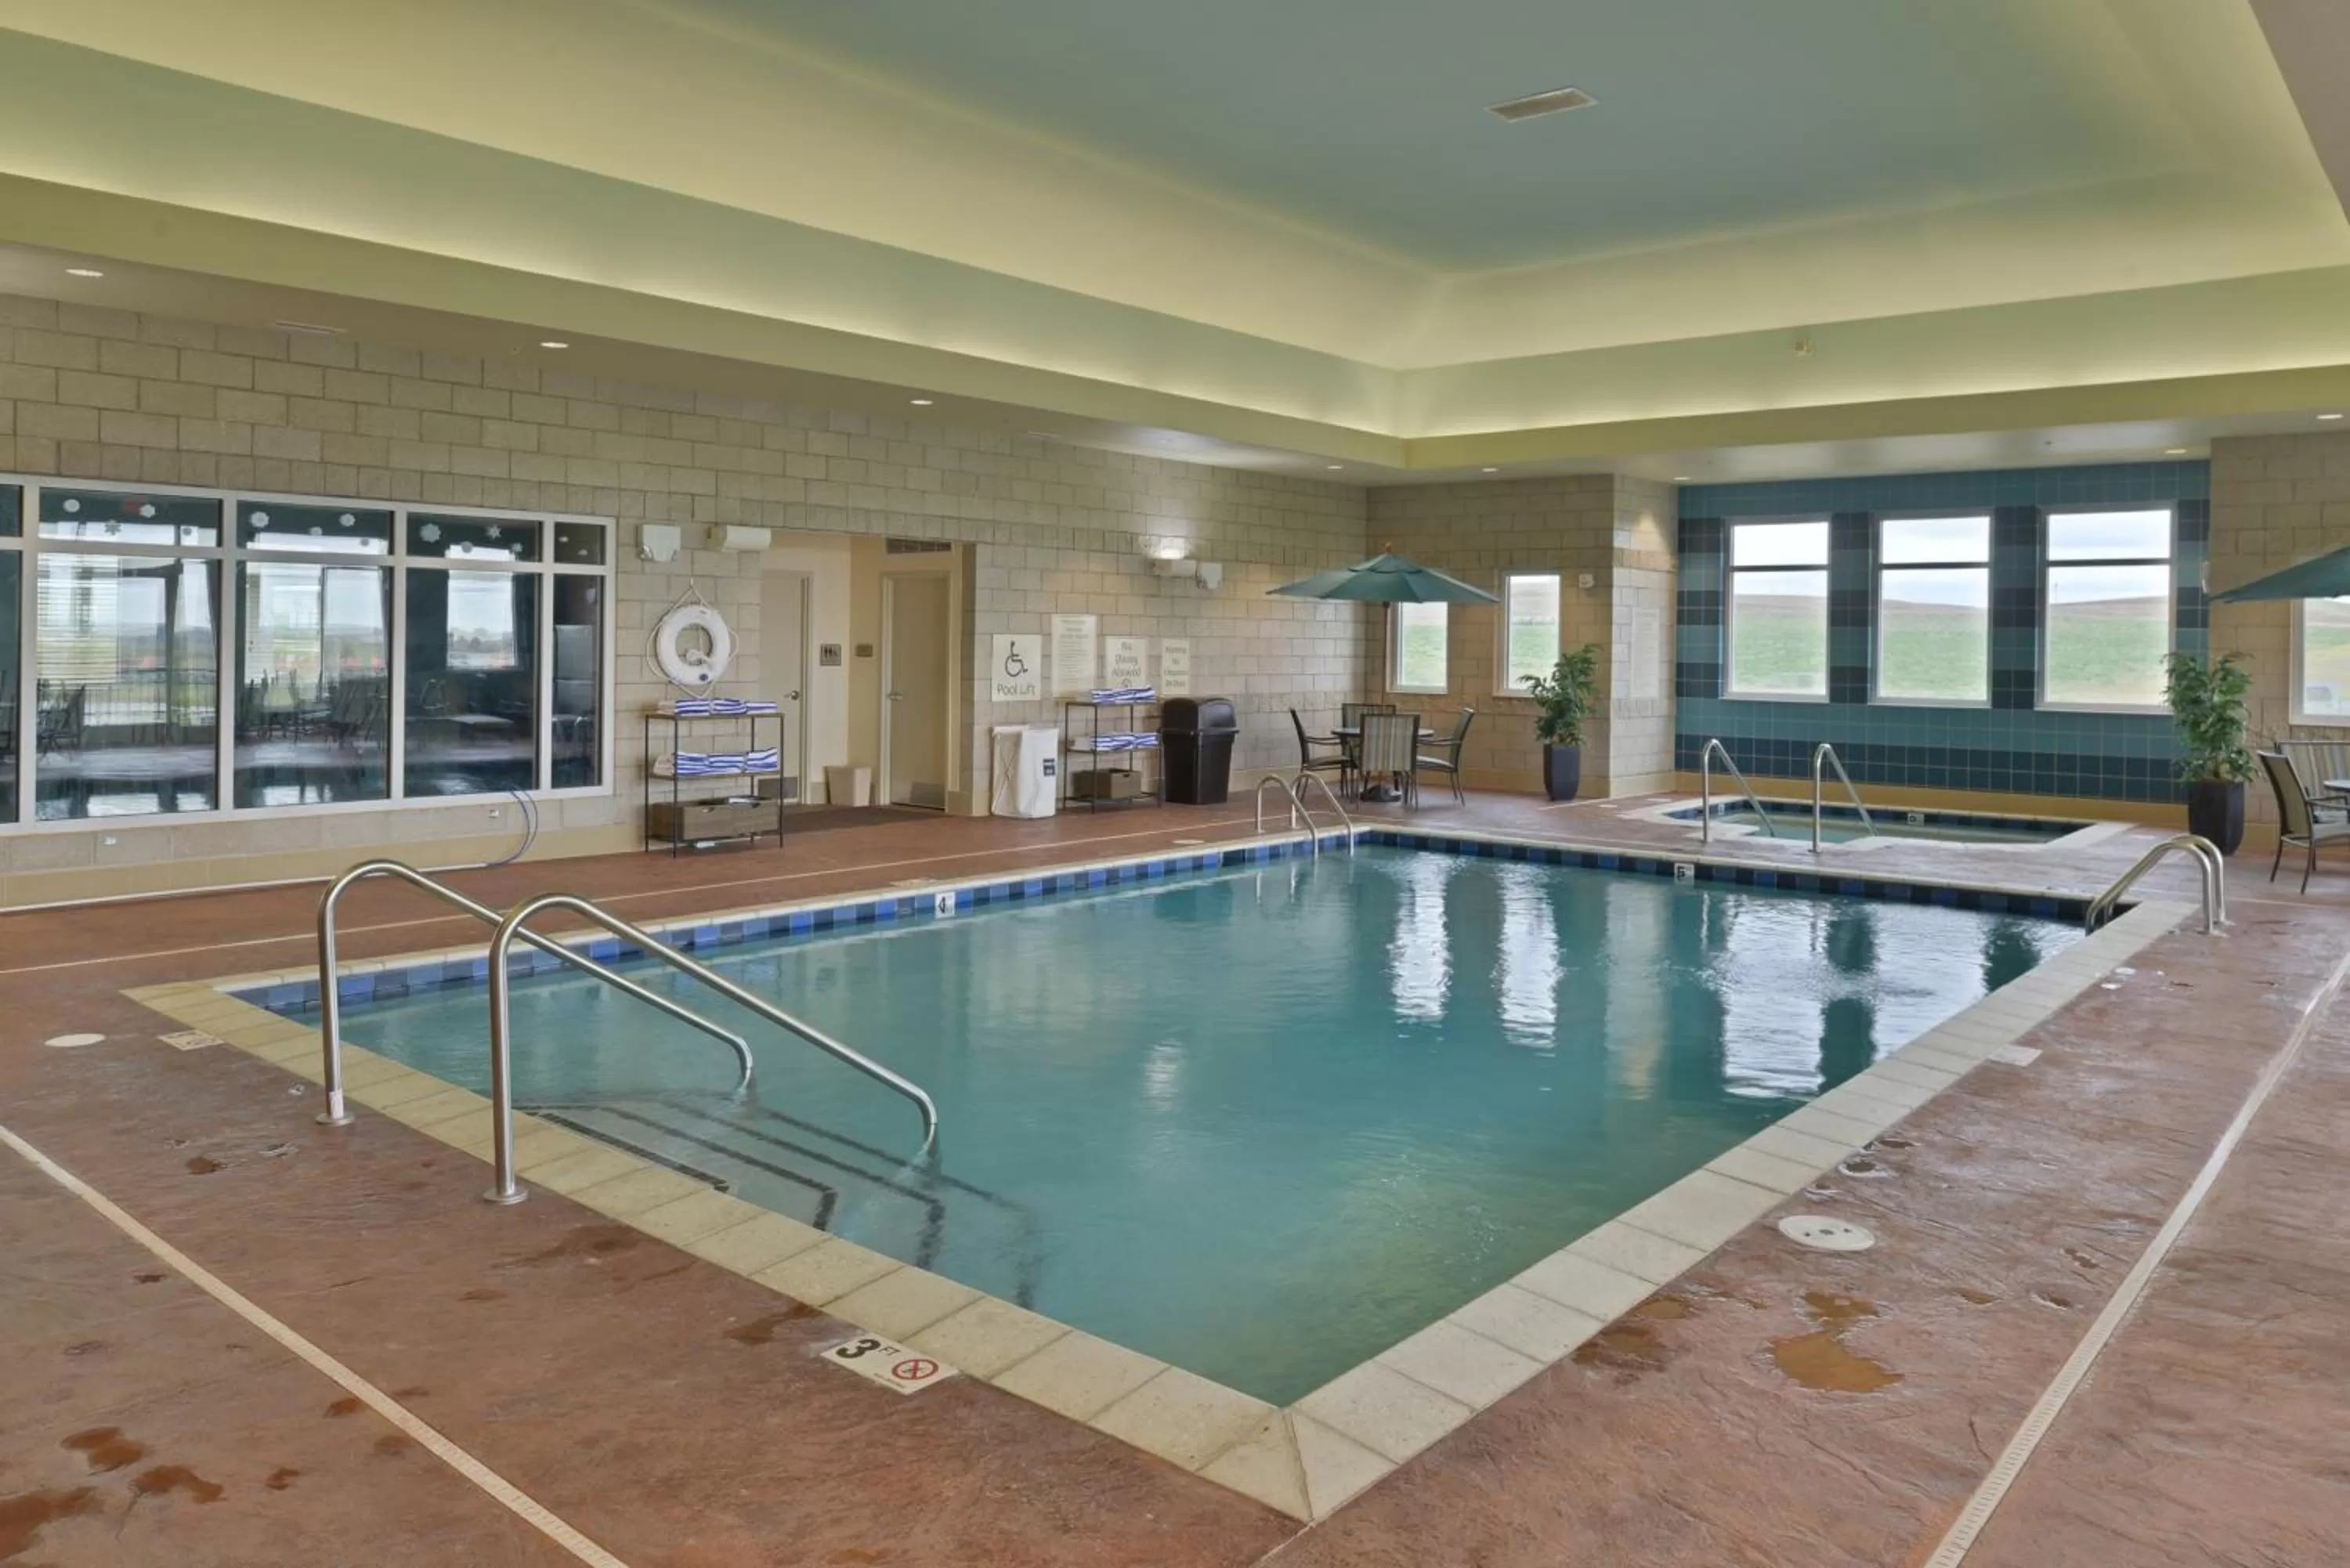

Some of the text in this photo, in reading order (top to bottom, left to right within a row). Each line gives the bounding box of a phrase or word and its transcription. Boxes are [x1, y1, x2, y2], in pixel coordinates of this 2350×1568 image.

[997, 682, 1036, 696] Pool Lift
[938, 895, 946, 914] 4
[835, 1339, 881, 1359] 3
